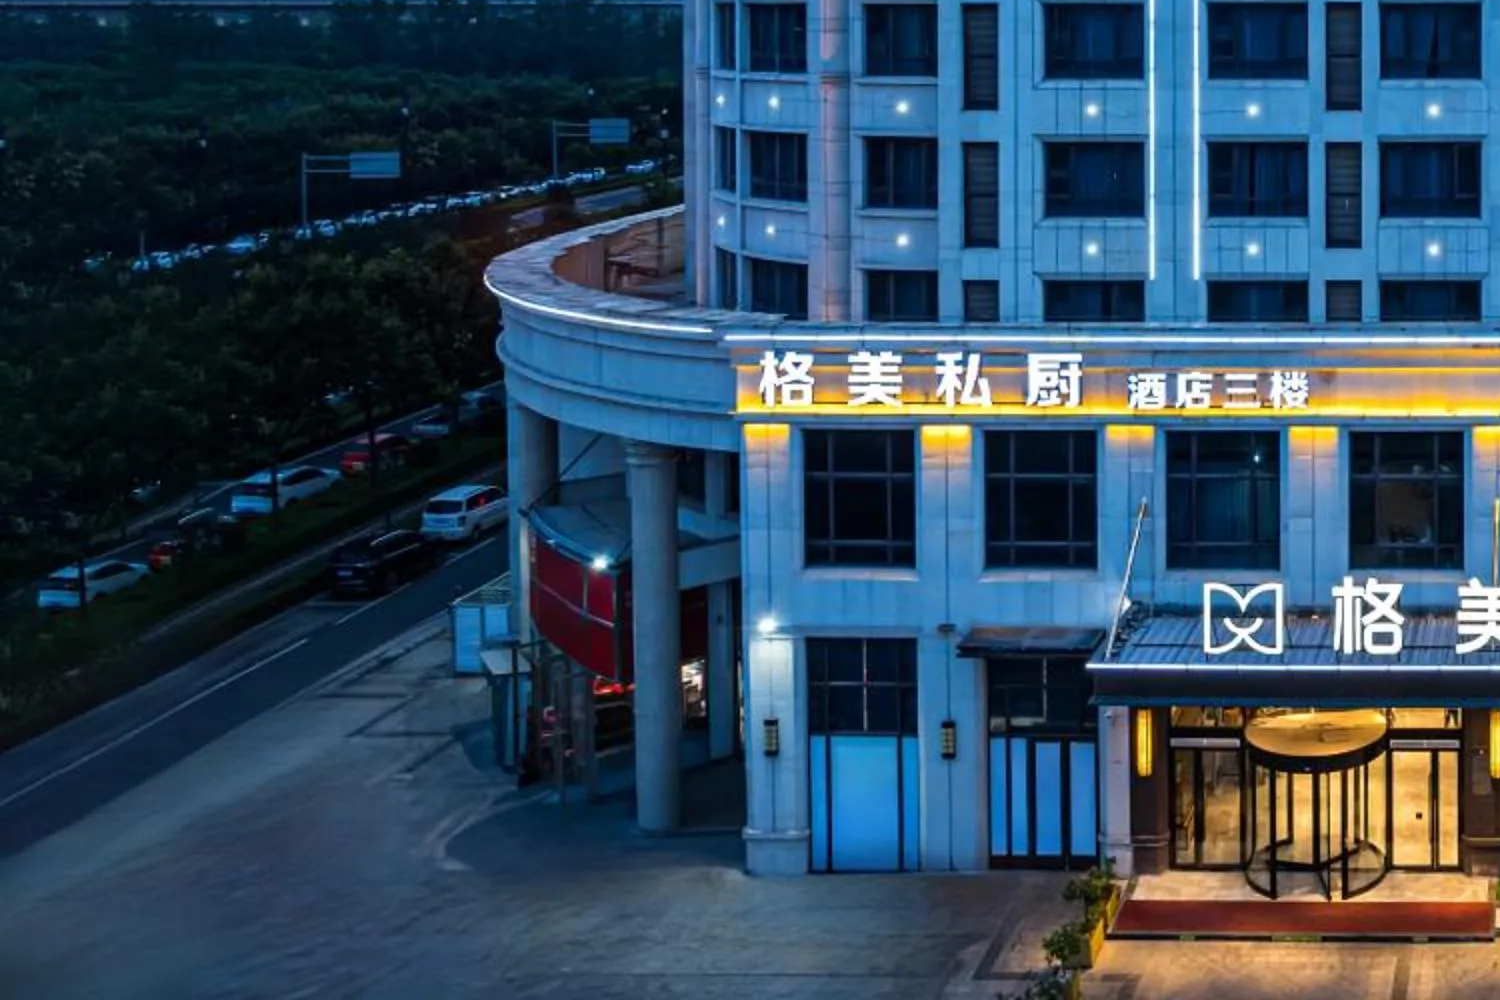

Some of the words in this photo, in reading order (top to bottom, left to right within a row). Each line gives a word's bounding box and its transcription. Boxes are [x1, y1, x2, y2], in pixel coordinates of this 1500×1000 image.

[758, 350, 1083, 407] 格美私厨
[1127, 370, 1310, 409] 酒店三楼
